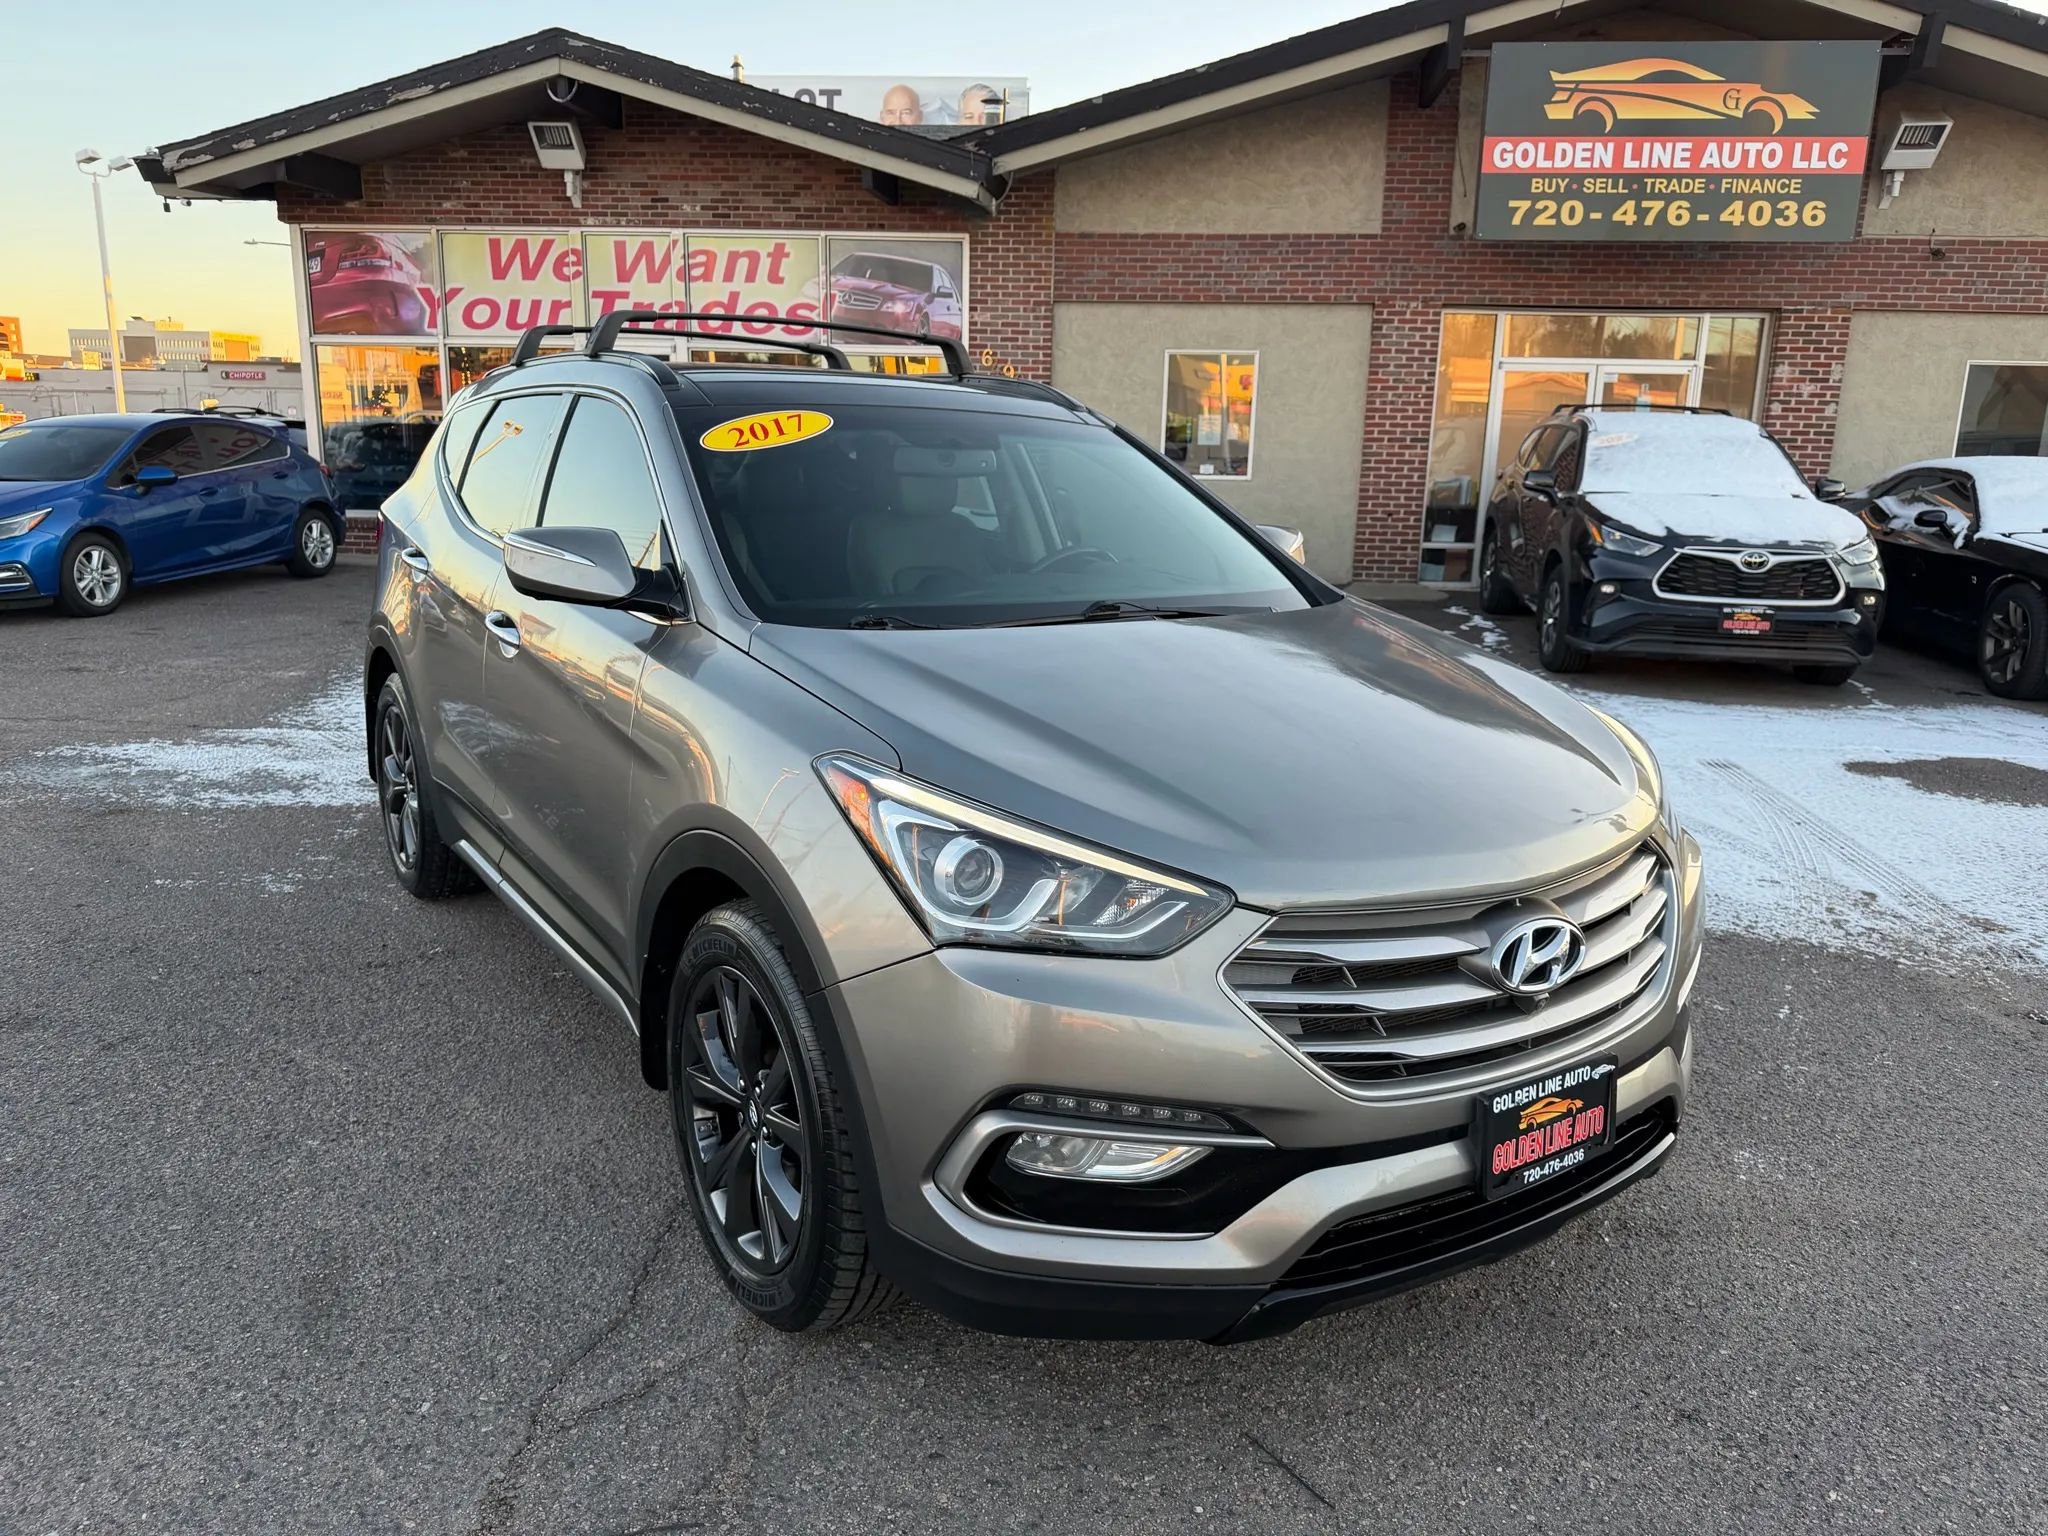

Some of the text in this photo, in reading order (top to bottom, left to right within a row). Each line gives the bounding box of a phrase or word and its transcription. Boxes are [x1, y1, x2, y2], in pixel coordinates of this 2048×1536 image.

[1493, 141, 1848, 169] GOLDEN LINE AUTO LLC
[1531, 178, 1802, 194] BUY SELL TRADE FINANCE
[488, 237, 791, 285] We Want
[416, 287, 572, 331] Your
[229, 371, 263, 379] CHIPOTLE
[727, 413, 802, 448] 2017
[1493, 1065, 1591, 1114] GOLDEN LINE AUTO
[1492, 1104, 1605, 1175] GOLDEN LINE AUTO
[1523, 1148, 1585, 1184] 720-476-4036
